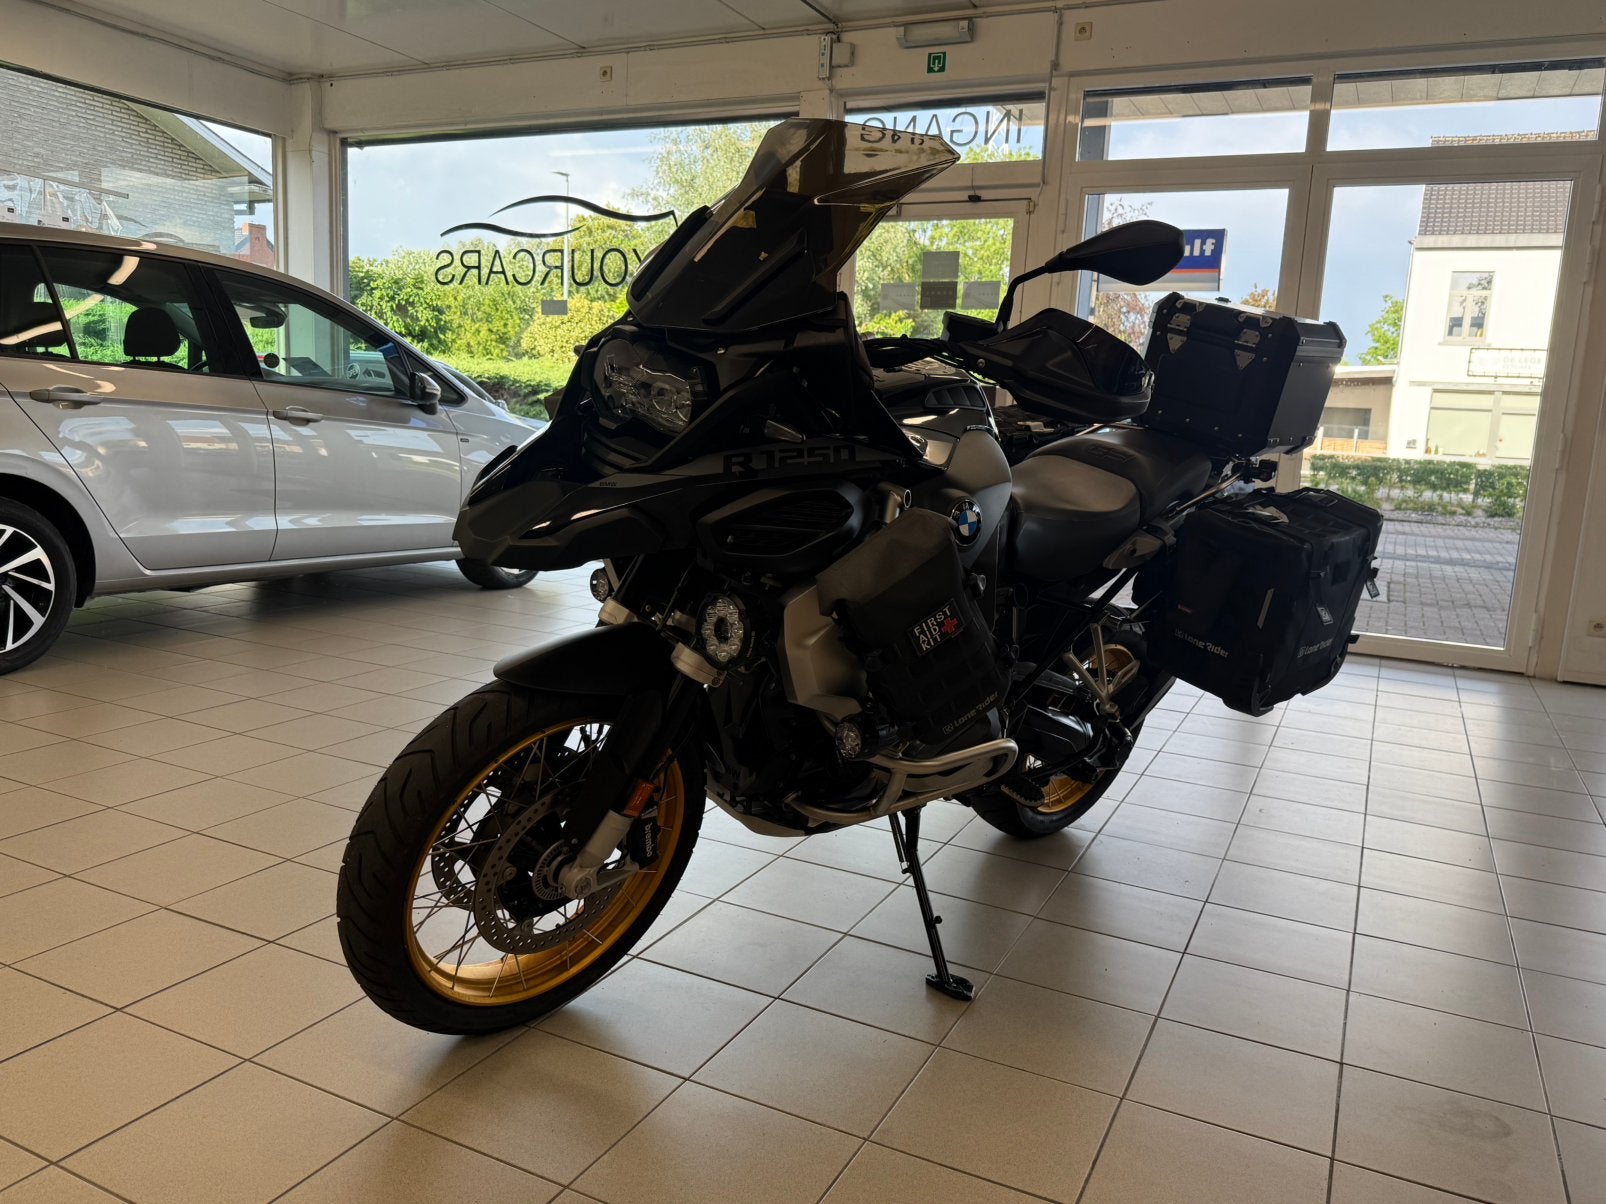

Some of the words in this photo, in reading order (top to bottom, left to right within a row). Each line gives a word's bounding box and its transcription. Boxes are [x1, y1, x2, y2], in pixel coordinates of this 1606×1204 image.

[1184, 238, 1216, 257] lf
[914, 604, 951, 637] FIRST
[920, 626, 940, 644] AID
[921, 632, 941, 651] KIT
[1184, 632, 1206, 649] Lone
[1206, 641, 1229, 658] Rider
[954, 709, 976, 728] Lone
[976, 690, 998, 711] Rider
